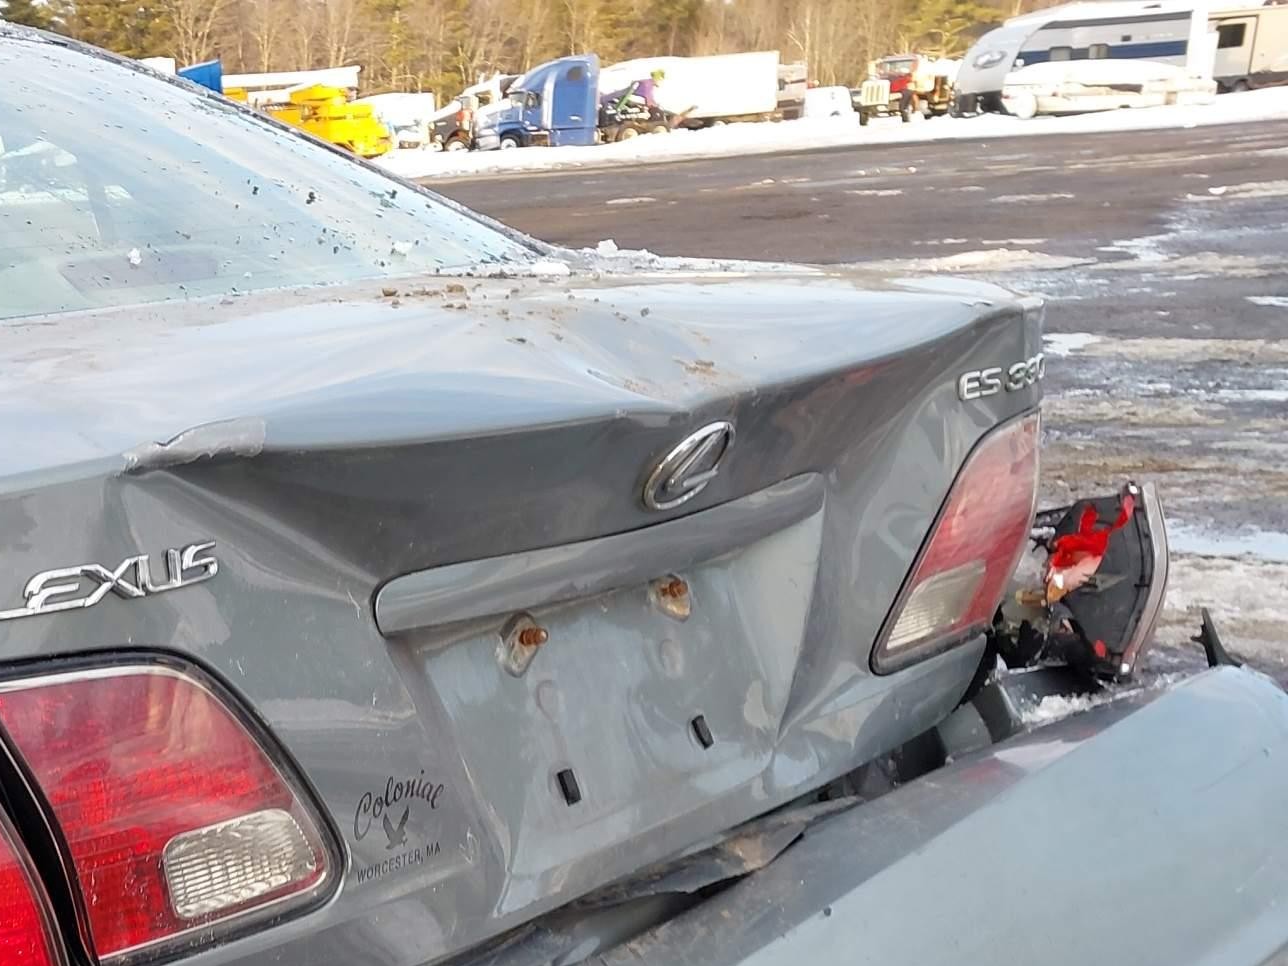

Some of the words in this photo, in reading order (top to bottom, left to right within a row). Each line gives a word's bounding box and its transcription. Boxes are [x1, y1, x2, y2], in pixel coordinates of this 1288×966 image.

[958, 367, 1002, 400] ES
[353, 769, 445, 842] Colonial
[426, 841, 441, 858] MA
